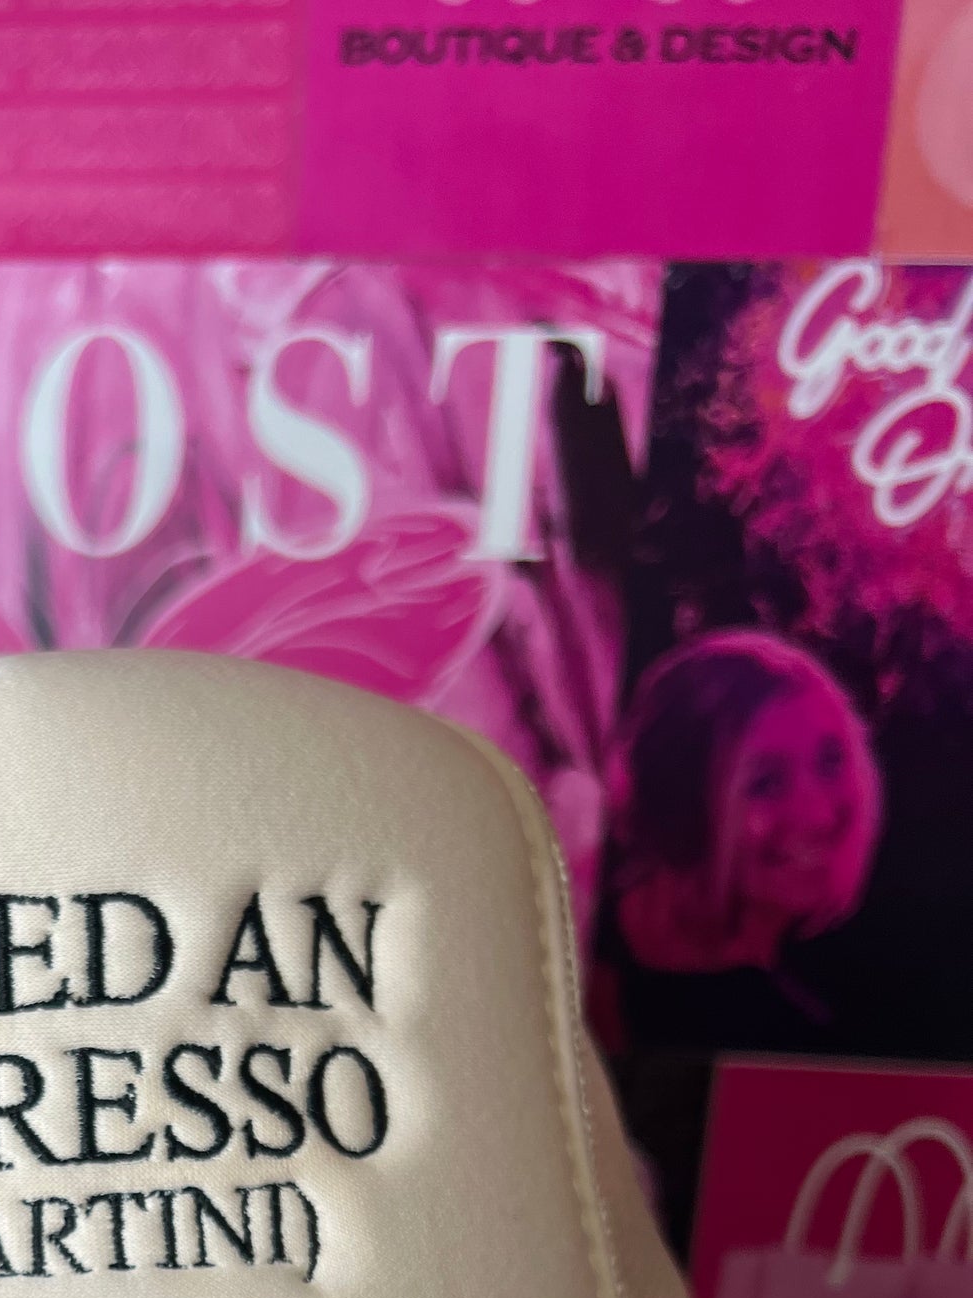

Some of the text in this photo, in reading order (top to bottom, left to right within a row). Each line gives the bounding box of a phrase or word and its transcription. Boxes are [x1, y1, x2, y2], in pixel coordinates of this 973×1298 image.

[340, 27, 859, 66] BOUTIQUE & DESIGN
[778, 260, 973, 421] Good
[210, 891, 383, 1011] AN
